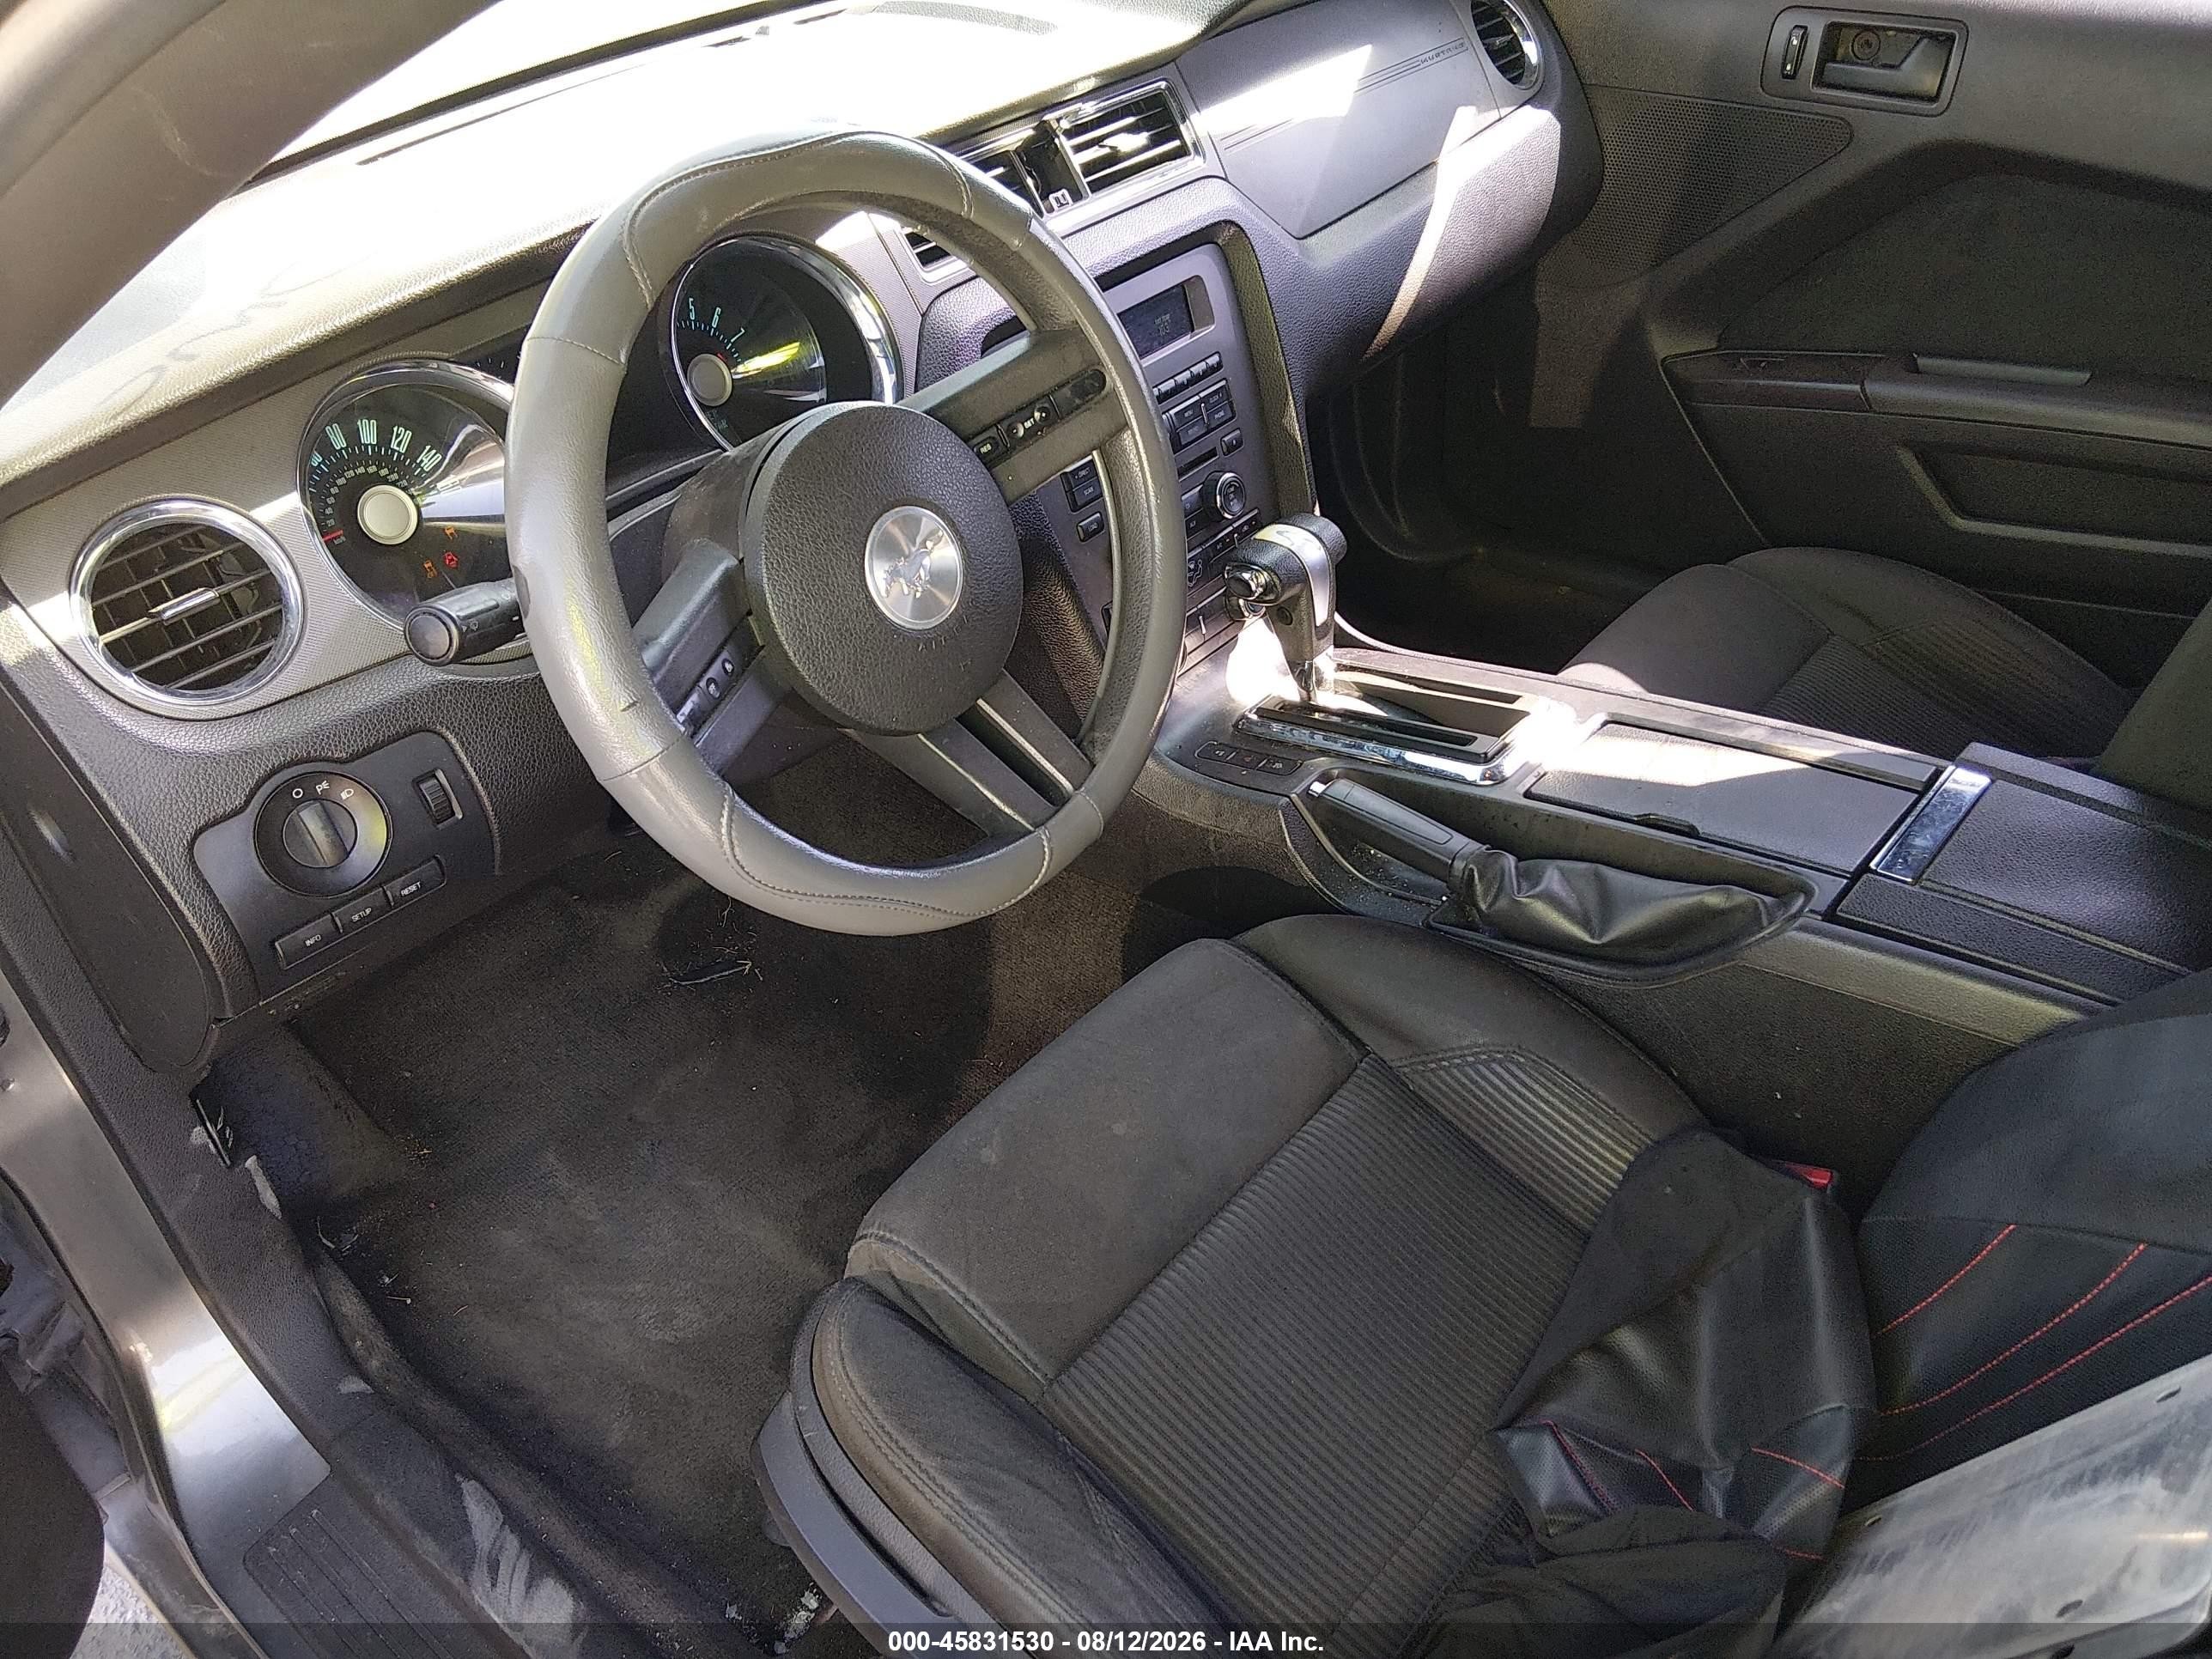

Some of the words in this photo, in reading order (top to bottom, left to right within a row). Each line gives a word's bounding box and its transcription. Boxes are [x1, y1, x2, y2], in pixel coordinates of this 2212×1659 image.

[689, 298, 696, 320] 5
[712, 307, 722, 328] 6
[731, 327, 745, 343] 7
[325, 423, 347, 450] 80
[357, 419, 377, 445] 100
[391, 426, 412, 453] 120
[980, 443, 992, 454] RES
[416, 445, 442, 472] 140
[344, 468, 356, 479] 120
[355, 465, 366, 476] 140
[367, 465, 378, 474] 160
[379, 467, 389, 477] 180
[336, 477, 347, 487] 100
[387, 472, 399, 483] 200
[330, 486, 339, 495] 80
[326, 496, 336, 505] 60
[325, 507, 334, 515] 40
[327, 518, 336, 526] 20
[400, 881, 422, 896] RESET
[351, 907, 372, 923] SETUP
[305, 934, 322, 947] INFO
